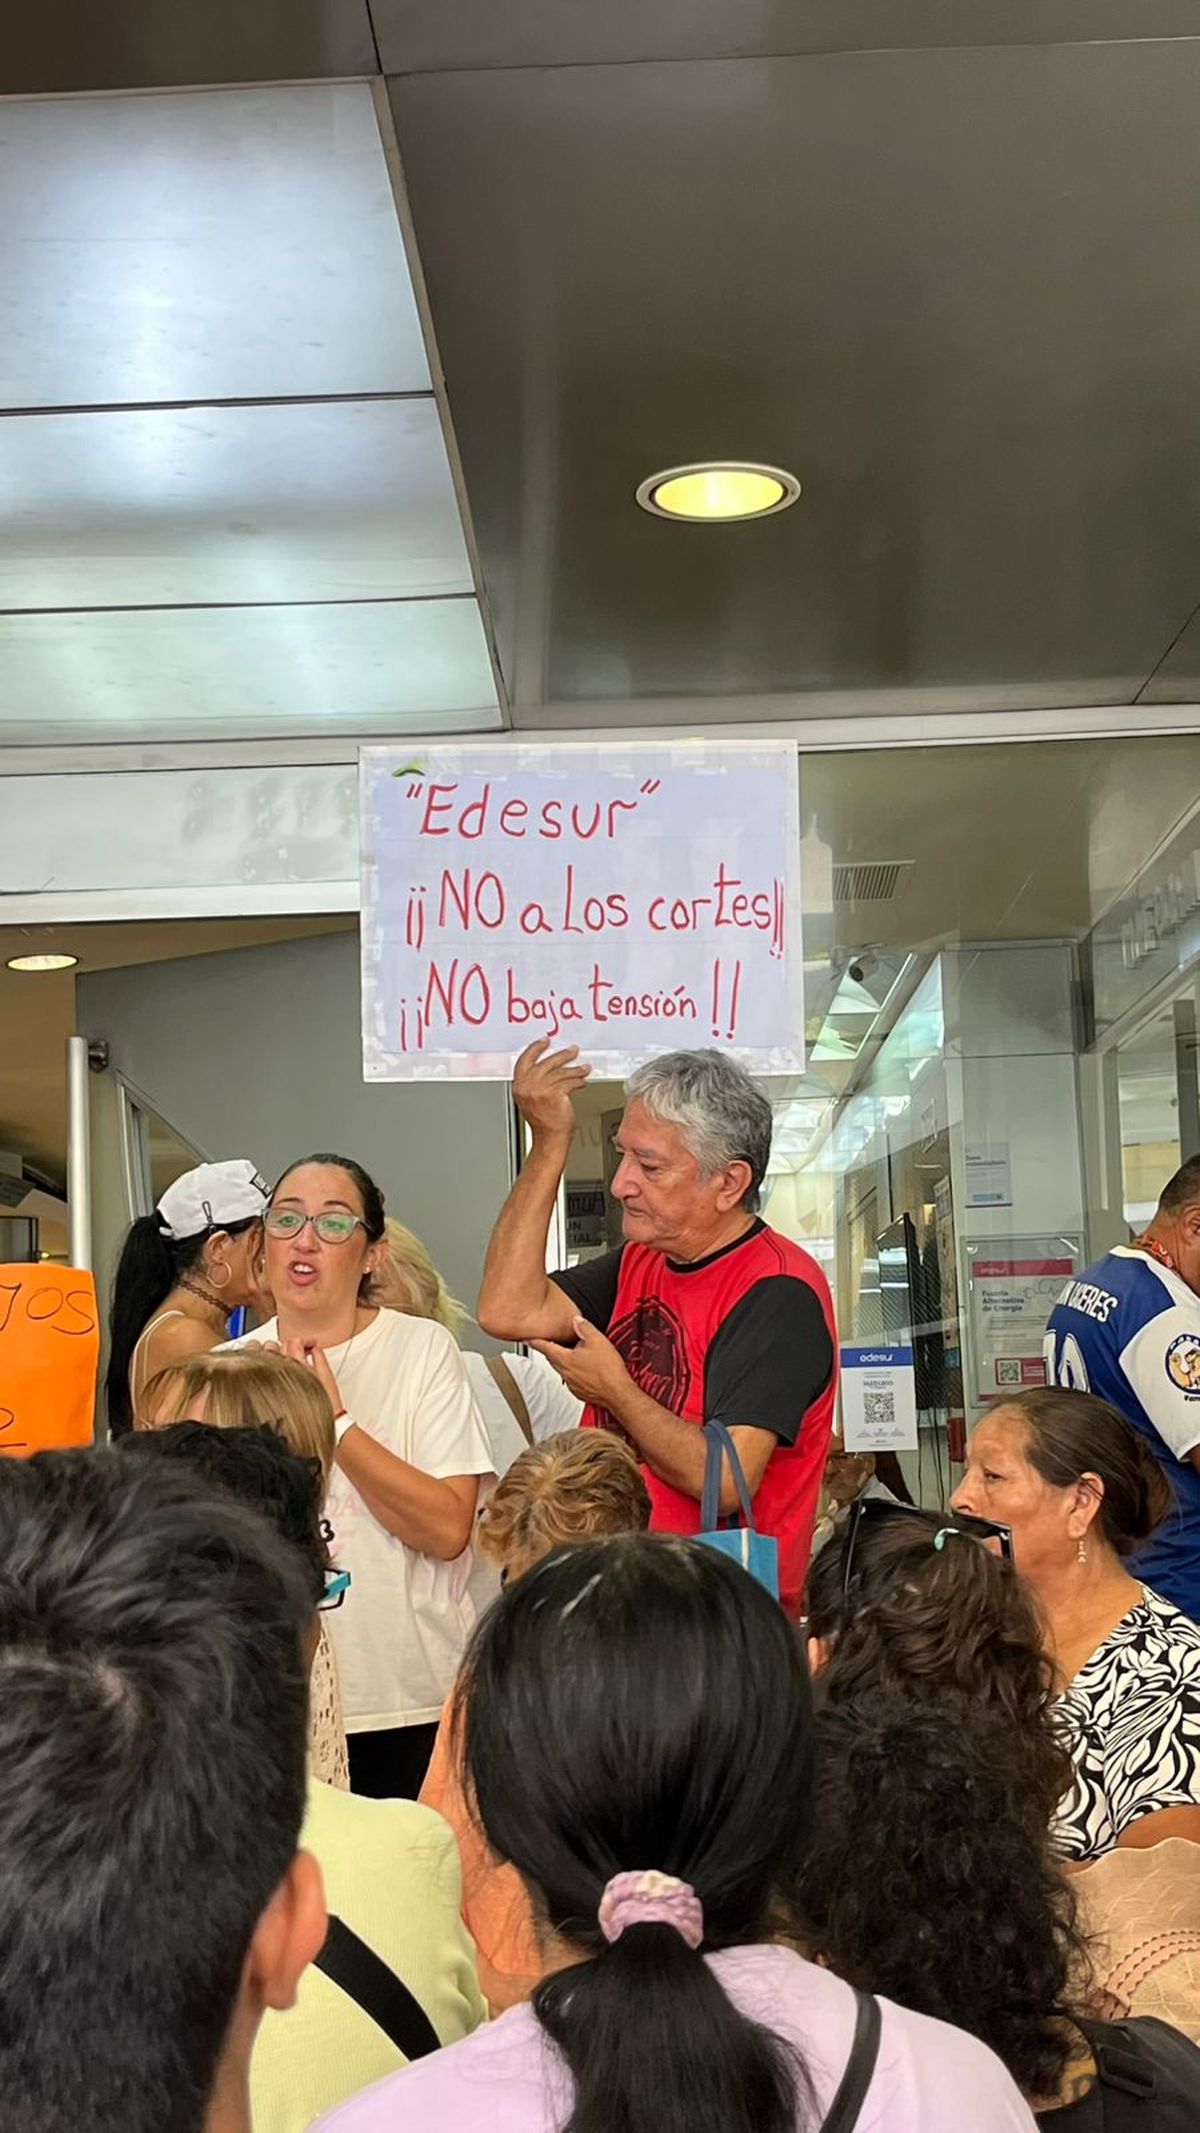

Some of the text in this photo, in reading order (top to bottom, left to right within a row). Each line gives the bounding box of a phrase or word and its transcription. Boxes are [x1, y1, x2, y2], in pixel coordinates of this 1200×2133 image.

[406, 779, 660, 839] "Edesur"
[520, 902, 553, 935] a
[506, 967, 583, 1037] baja
[588, 963, 697, 1022] tensión
